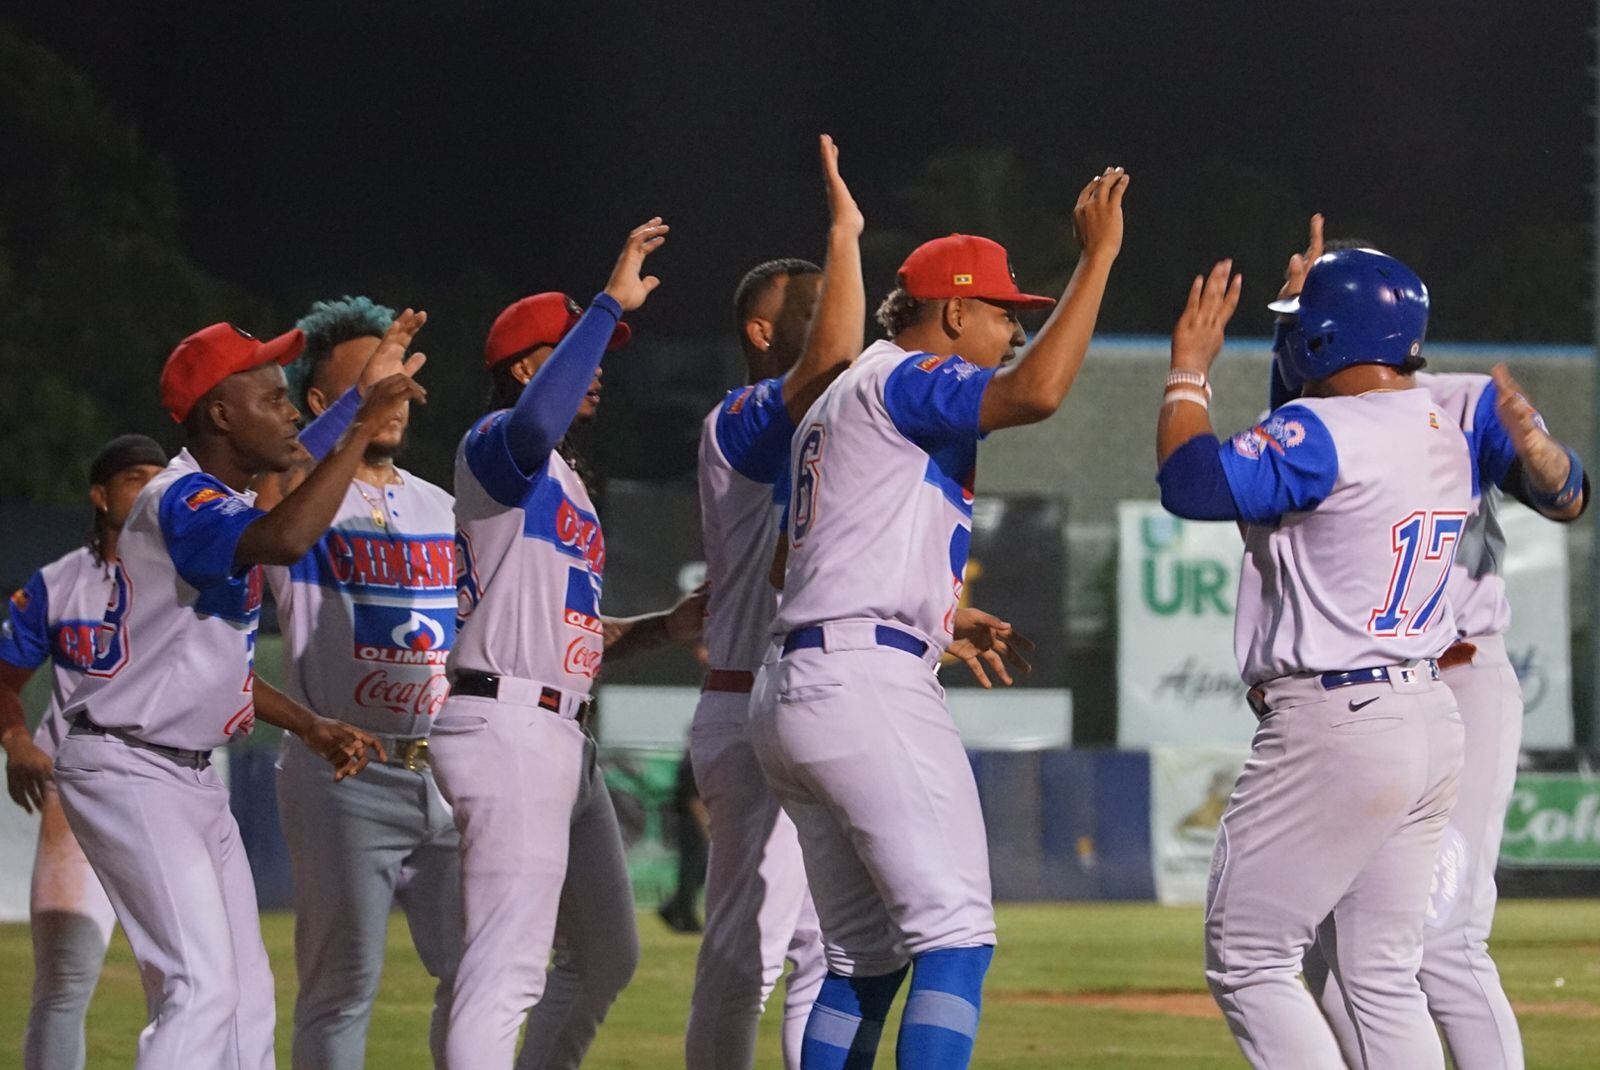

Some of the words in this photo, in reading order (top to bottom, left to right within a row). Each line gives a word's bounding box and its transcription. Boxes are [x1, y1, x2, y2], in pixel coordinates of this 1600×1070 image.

[793, 422, 826, 550] 6
[328, 533, 457, 591] CAIMAN
[1367, 510, 1467, 637] 17
[1504, 790, 1600, 845] Col
